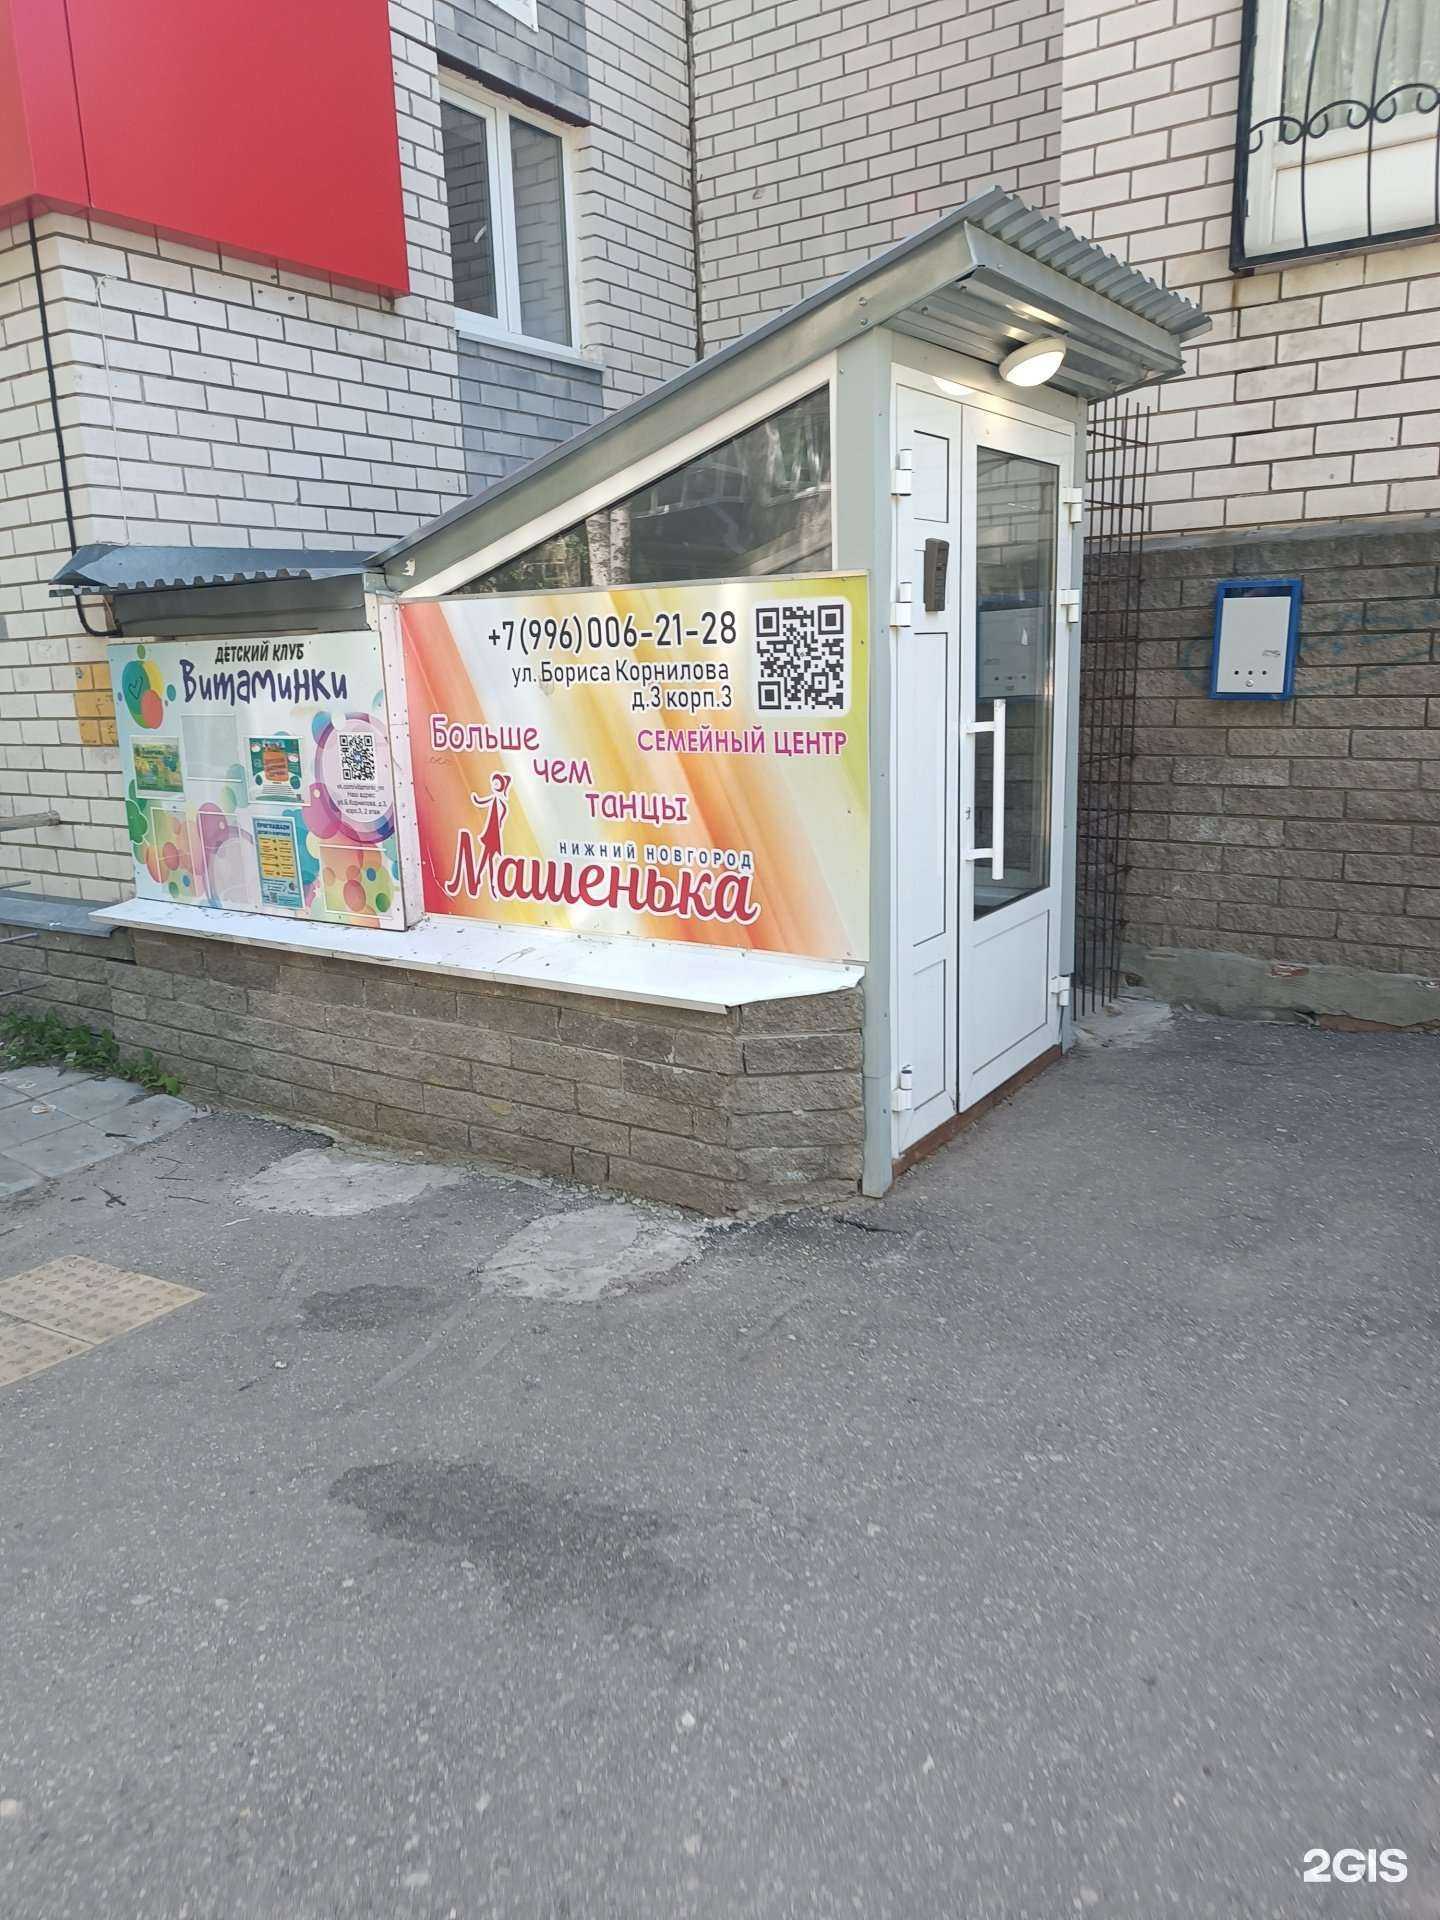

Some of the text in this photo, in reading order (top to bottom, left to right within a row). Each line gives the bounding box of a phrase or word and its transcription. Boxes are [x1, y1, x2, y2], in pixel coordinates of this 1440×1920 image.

[488, 611, 737, 655] +7(996)006-21-28
[215, 640, 305, 664] ДЕТСКИЙ КЛУБ
[179, 659, 348, 706] Витаминки
[541, 661, 610, 687] Бориса
[616, 659, 729, 687] Корнилова
[632, 684, 732, 713] д.3 корп.3
[432, 717, 540, 750] Больше
[637, 724, 847, 757] СЕМЕЙНЫЙ ЦЕНТР
[534, 759, 592, 784] чем
[585, 793, 688, 824] танцы
[559, 841, 754, 871] НИЖНИЙ НОВГОРОД
[447, 831, 759, 922] Машенька
